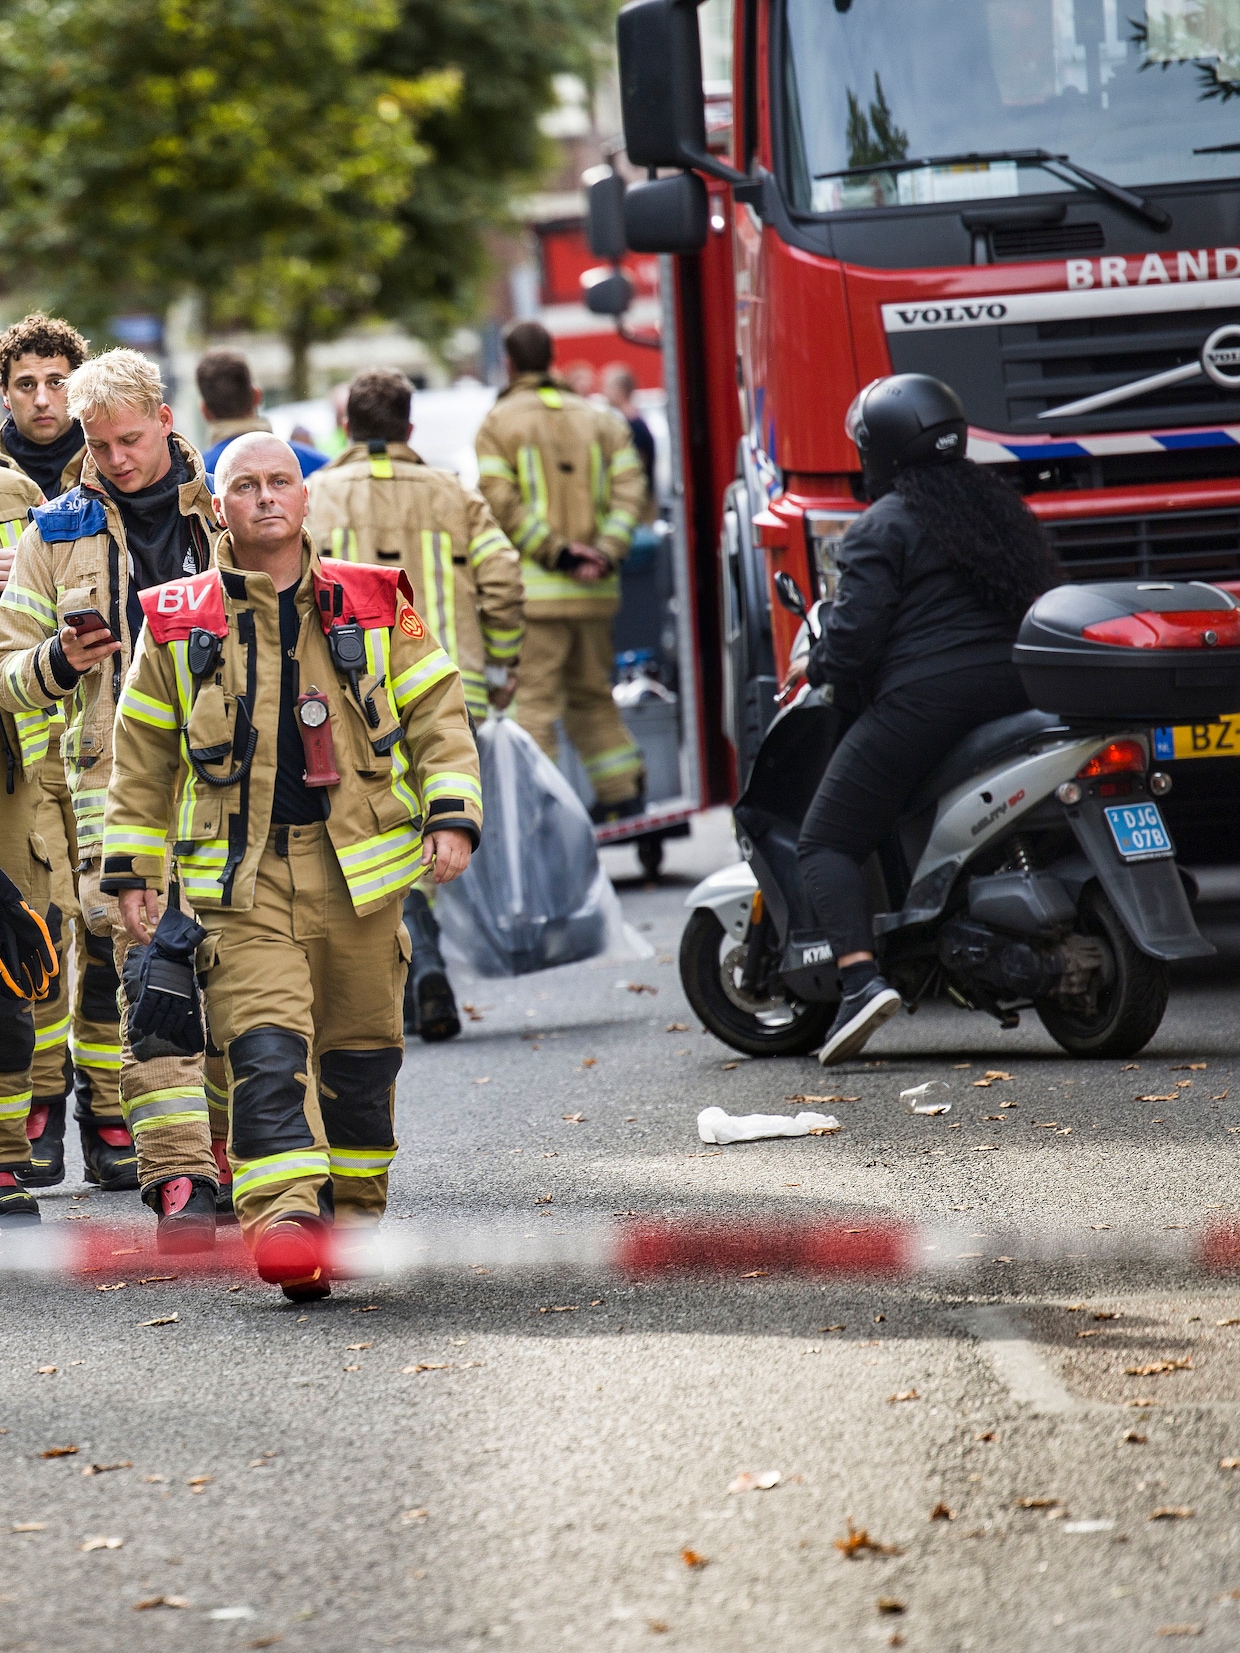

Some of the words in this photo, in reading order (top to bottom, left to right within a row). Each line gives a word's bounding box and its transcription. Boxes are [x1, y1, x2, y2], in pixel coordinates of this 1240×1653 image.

[1065, 247, 1240, 290] BRAND
[895, 303, 1008, 326] VOLVO
[157, 584, 213, 613] BV
[1123, 807, 1158, 829] DJG
[1132, 828, 1165, 849] 07B
